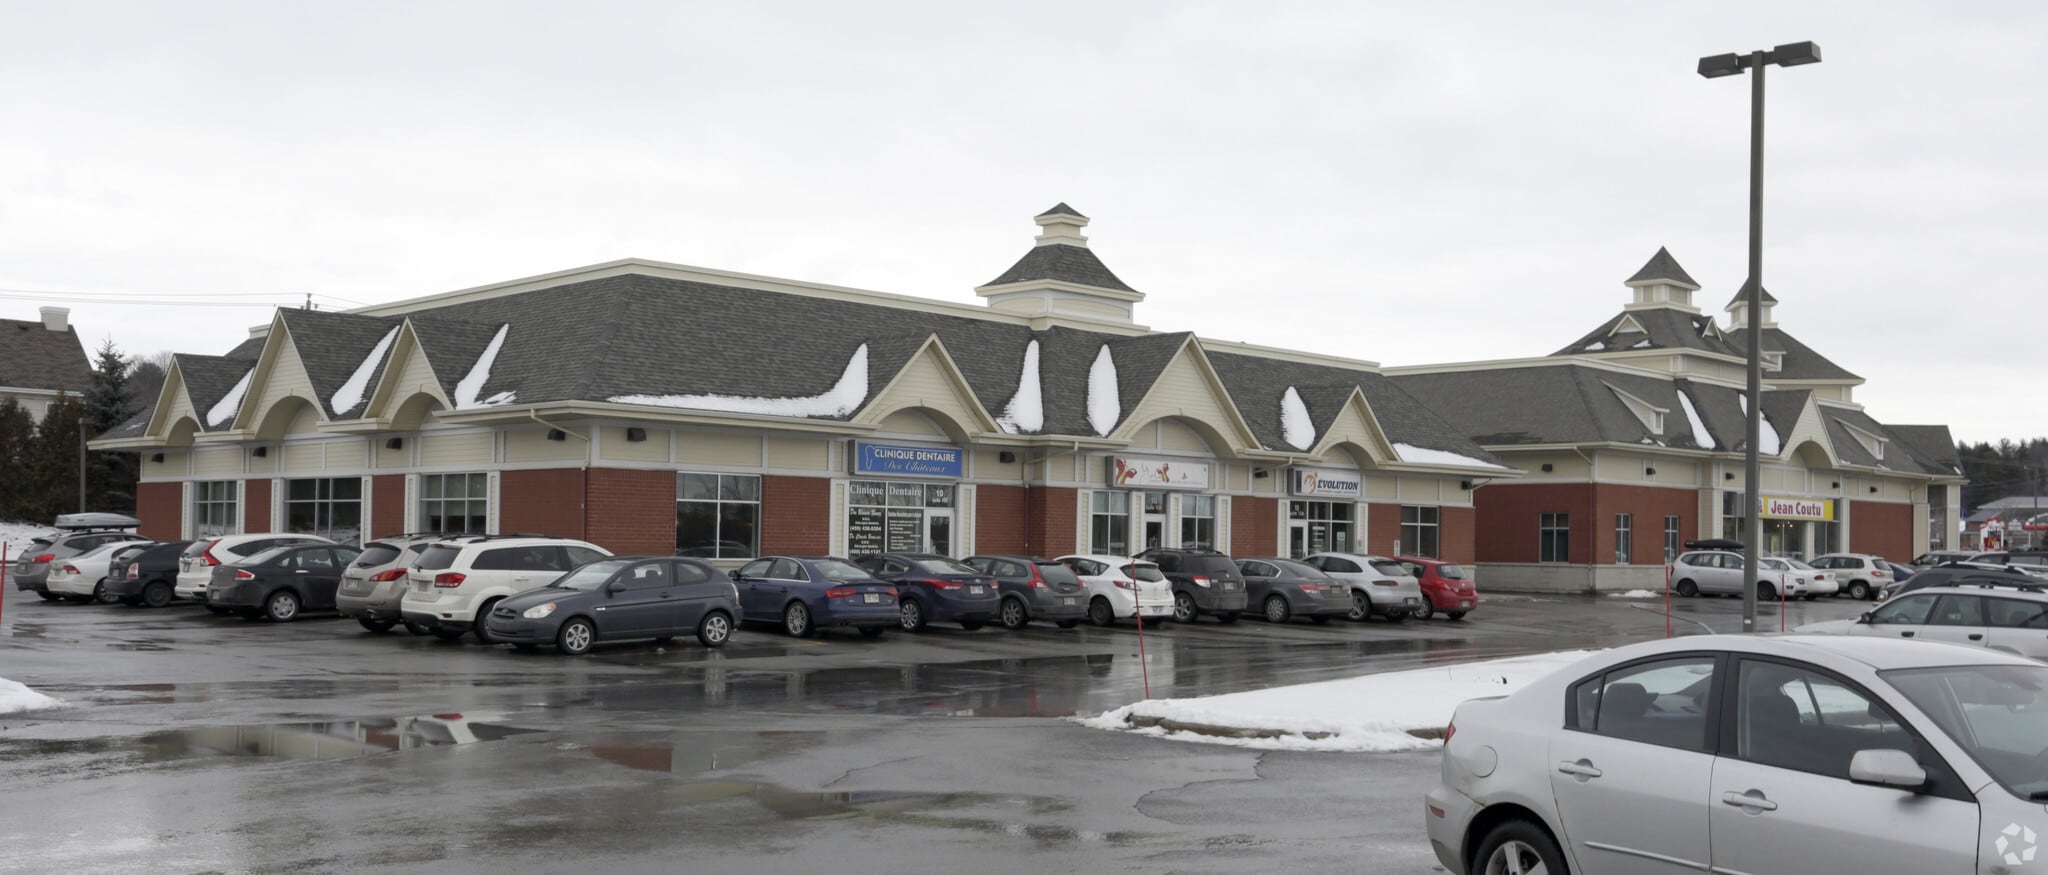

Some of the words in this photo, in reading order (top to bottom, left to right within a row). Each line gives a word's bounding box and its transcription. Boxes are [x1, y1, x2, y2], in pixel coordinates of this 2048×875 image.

[874, 448, 914, 460] CLINIQUE
[917, 451, 956, 463] DENTAIRE
[850, 484, 884, 497] Clinique
[889, 485, 922, 497] Dentaire
[1317, 477, 1358, 491] ÉVOLUTION
[936, 489, 944, 497] 10
[1771, 501, 1793, 515] Jean
[1796, 502, 1821, 516] Coutu
